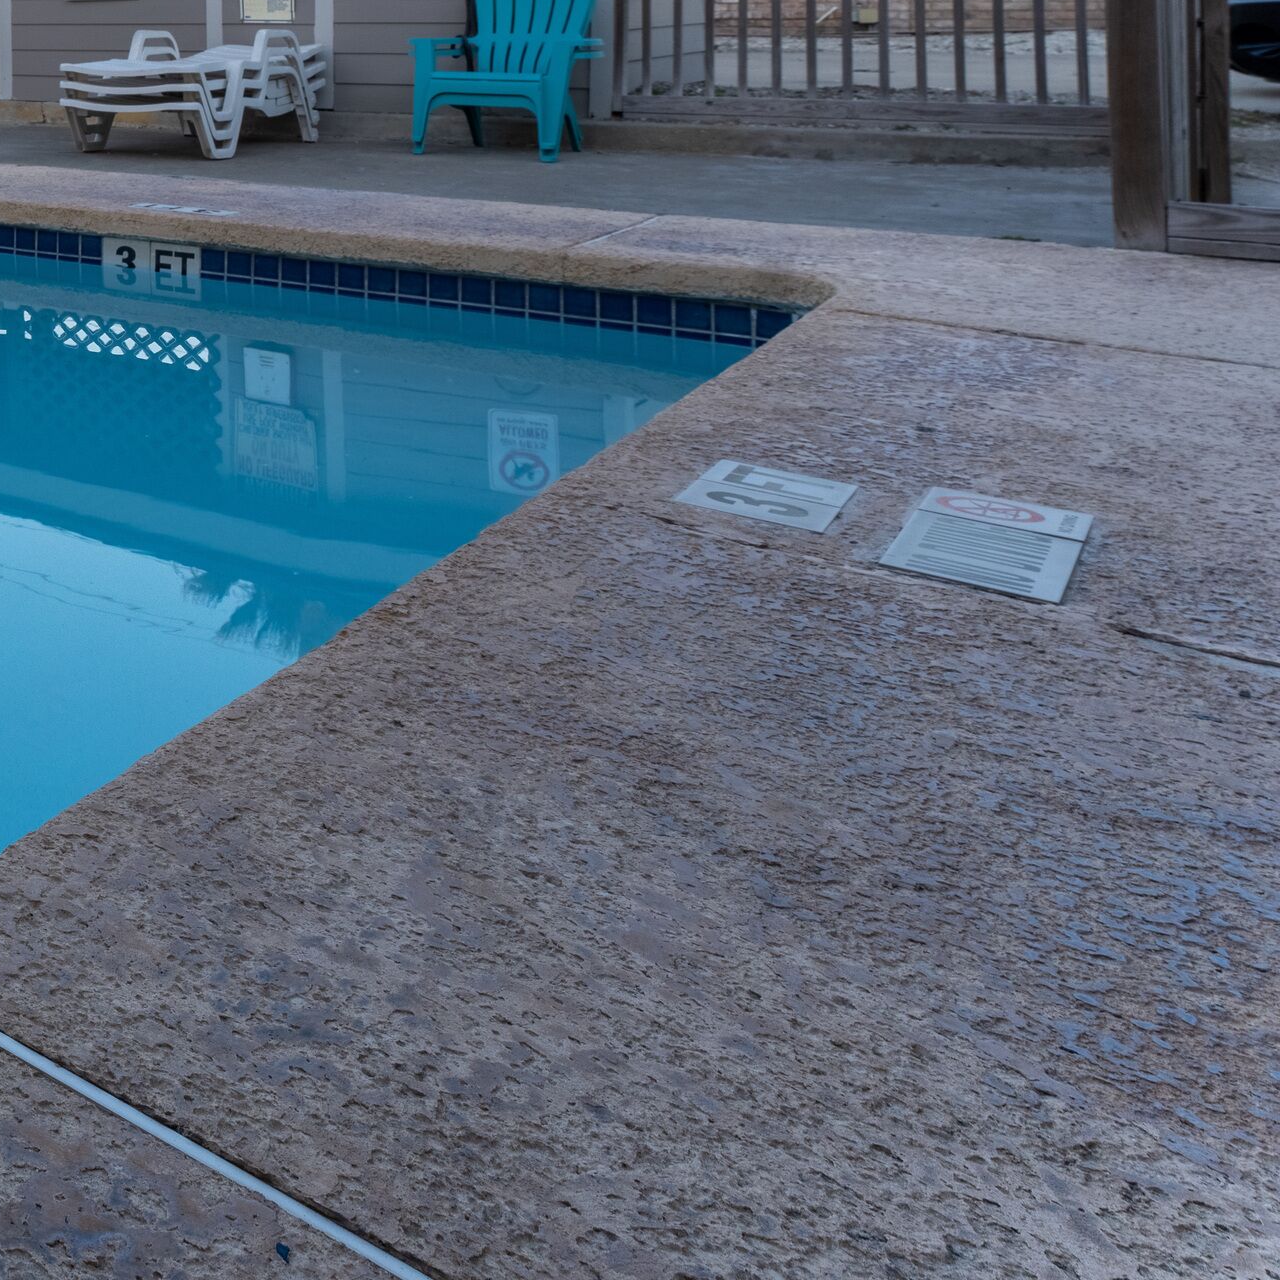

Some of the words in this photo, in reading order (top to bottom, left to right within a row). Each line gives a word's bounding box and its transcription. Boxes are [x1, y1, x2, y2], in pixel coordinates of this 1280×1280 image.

[116, 245, 136, 268] 3
[155, 249, 195, 276] FT
[723, 464, 836, 501] FT
[705, 490, 810, 518] 3
